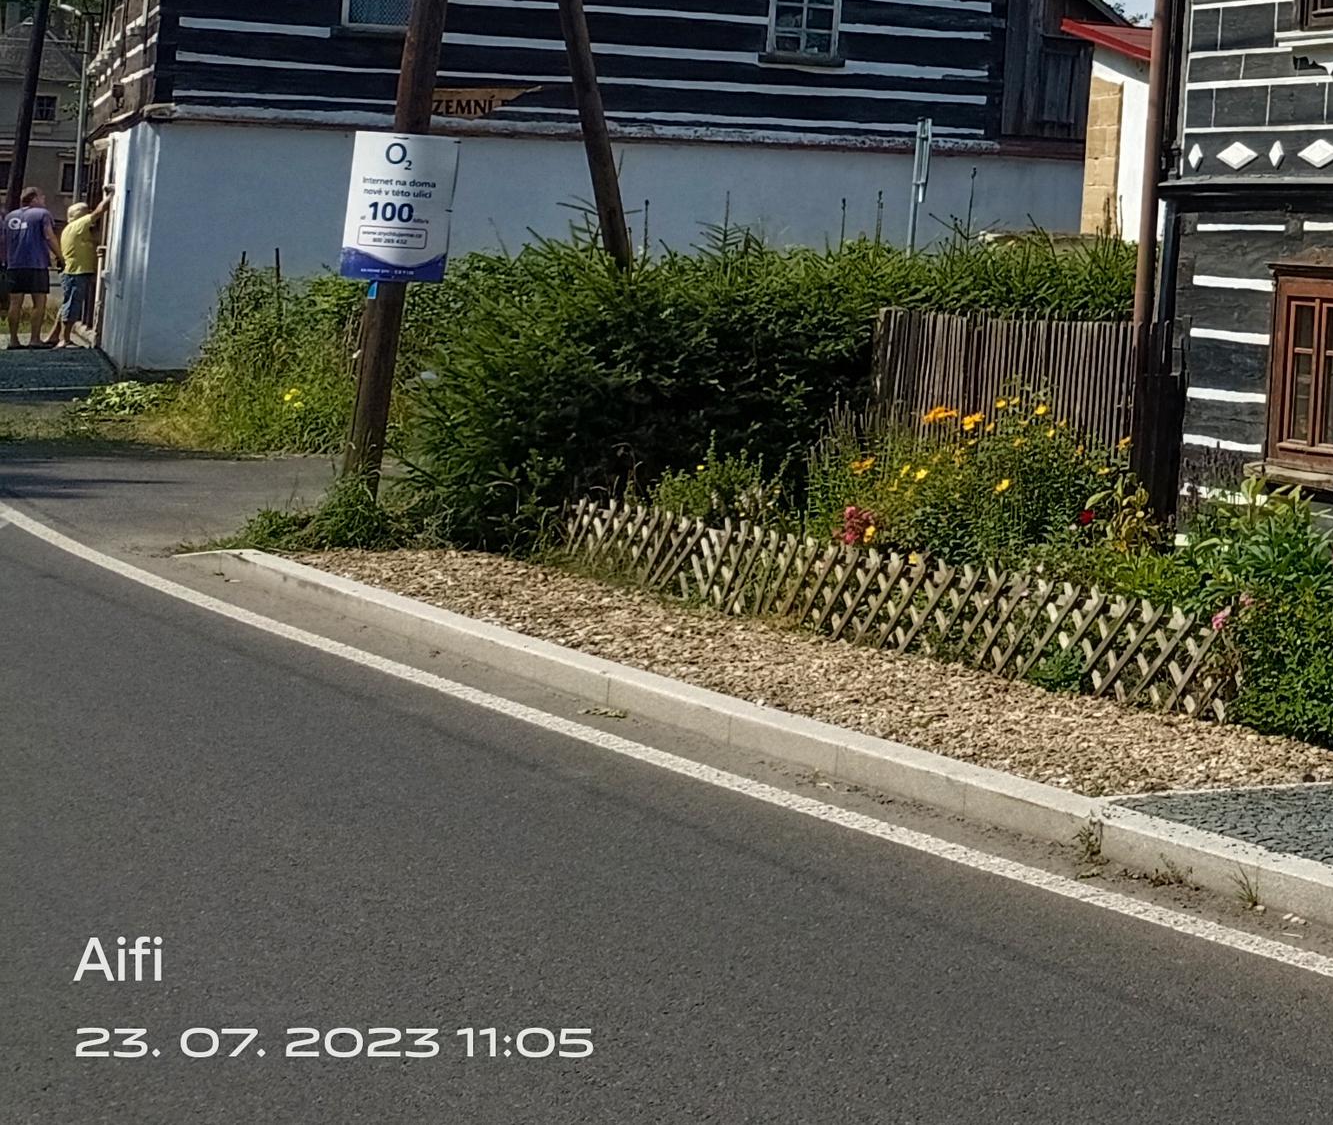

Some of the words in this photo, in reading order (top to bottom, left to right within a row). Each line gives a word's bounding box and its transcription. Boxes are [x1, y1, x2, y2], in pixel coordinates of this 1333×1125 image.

[385, 142, 412, 171] O2
[395, 179, 407, 187] na
[408, 179, 437, 189] doma
[368, 201, 414, 223] 100
